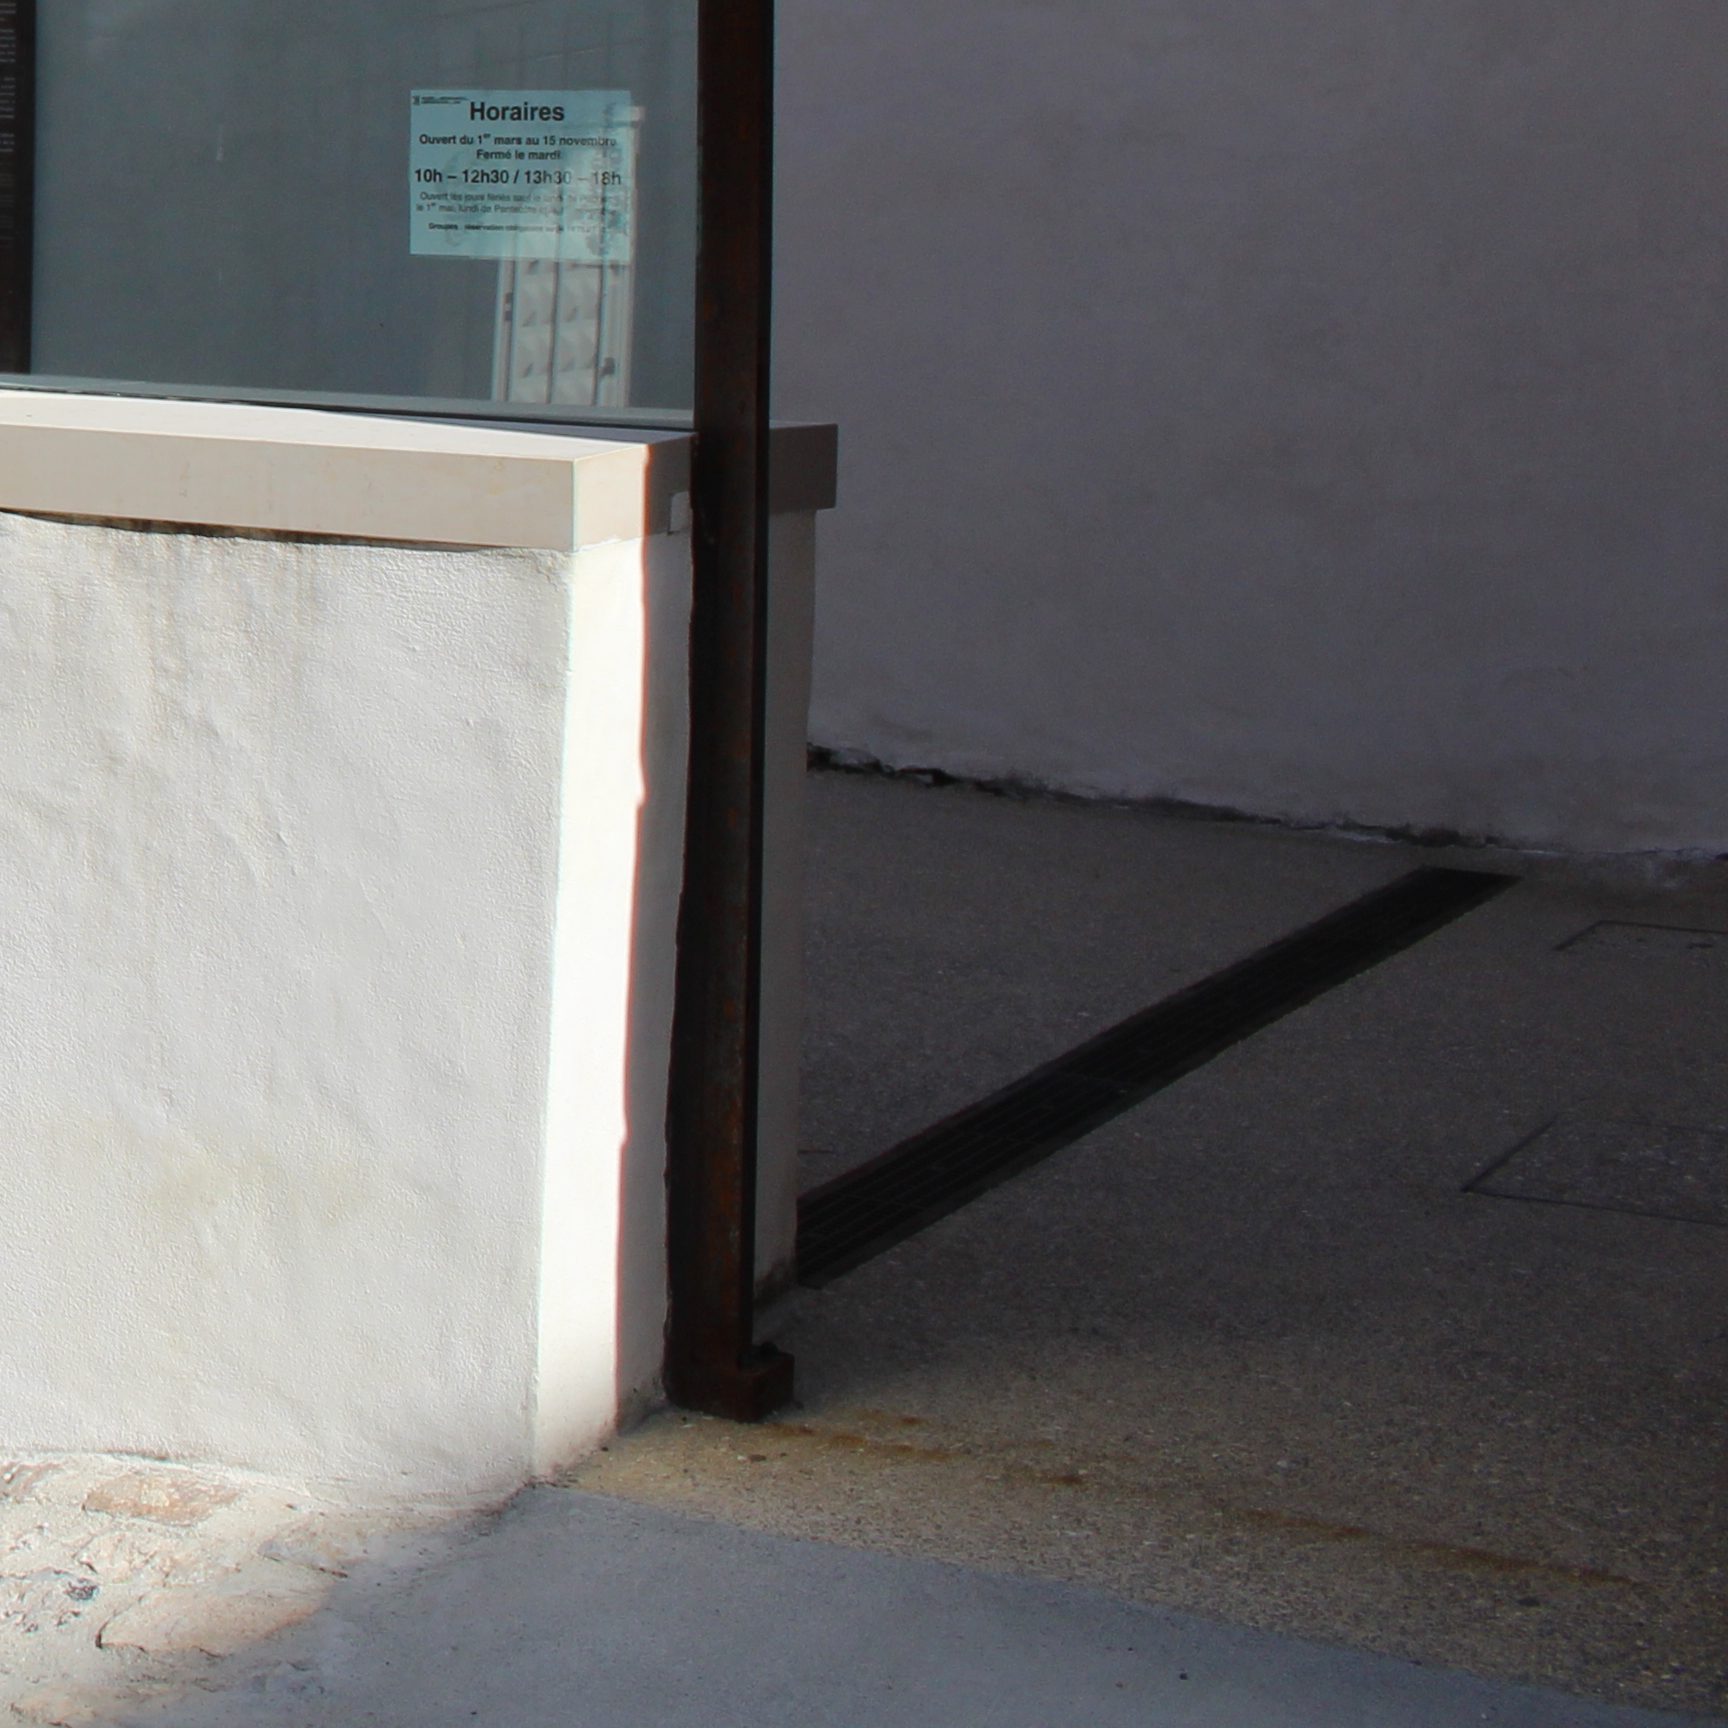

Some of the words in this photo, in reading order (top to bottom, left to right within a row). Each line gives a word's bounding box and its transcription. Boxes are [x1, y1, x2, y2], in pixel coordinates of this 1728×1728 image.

[470, 101, 565, 122] Horaires
[419, 134, 456, 145] Ouvert
[460, 134, 474, 145] du
[494, 137, 522, 146] mars
[525, 137, 539, 146] au
[543, 135, 556, 146] 15
[476, 149, 511, 160] Fermé
[515, 149, 524, 160] le
[528, 149, 561, 160] mardi
[415, 169, 442, 183] 10h
[462, 169, 509, 184] 12h30
[524, 170, 571, 184] 13h30
